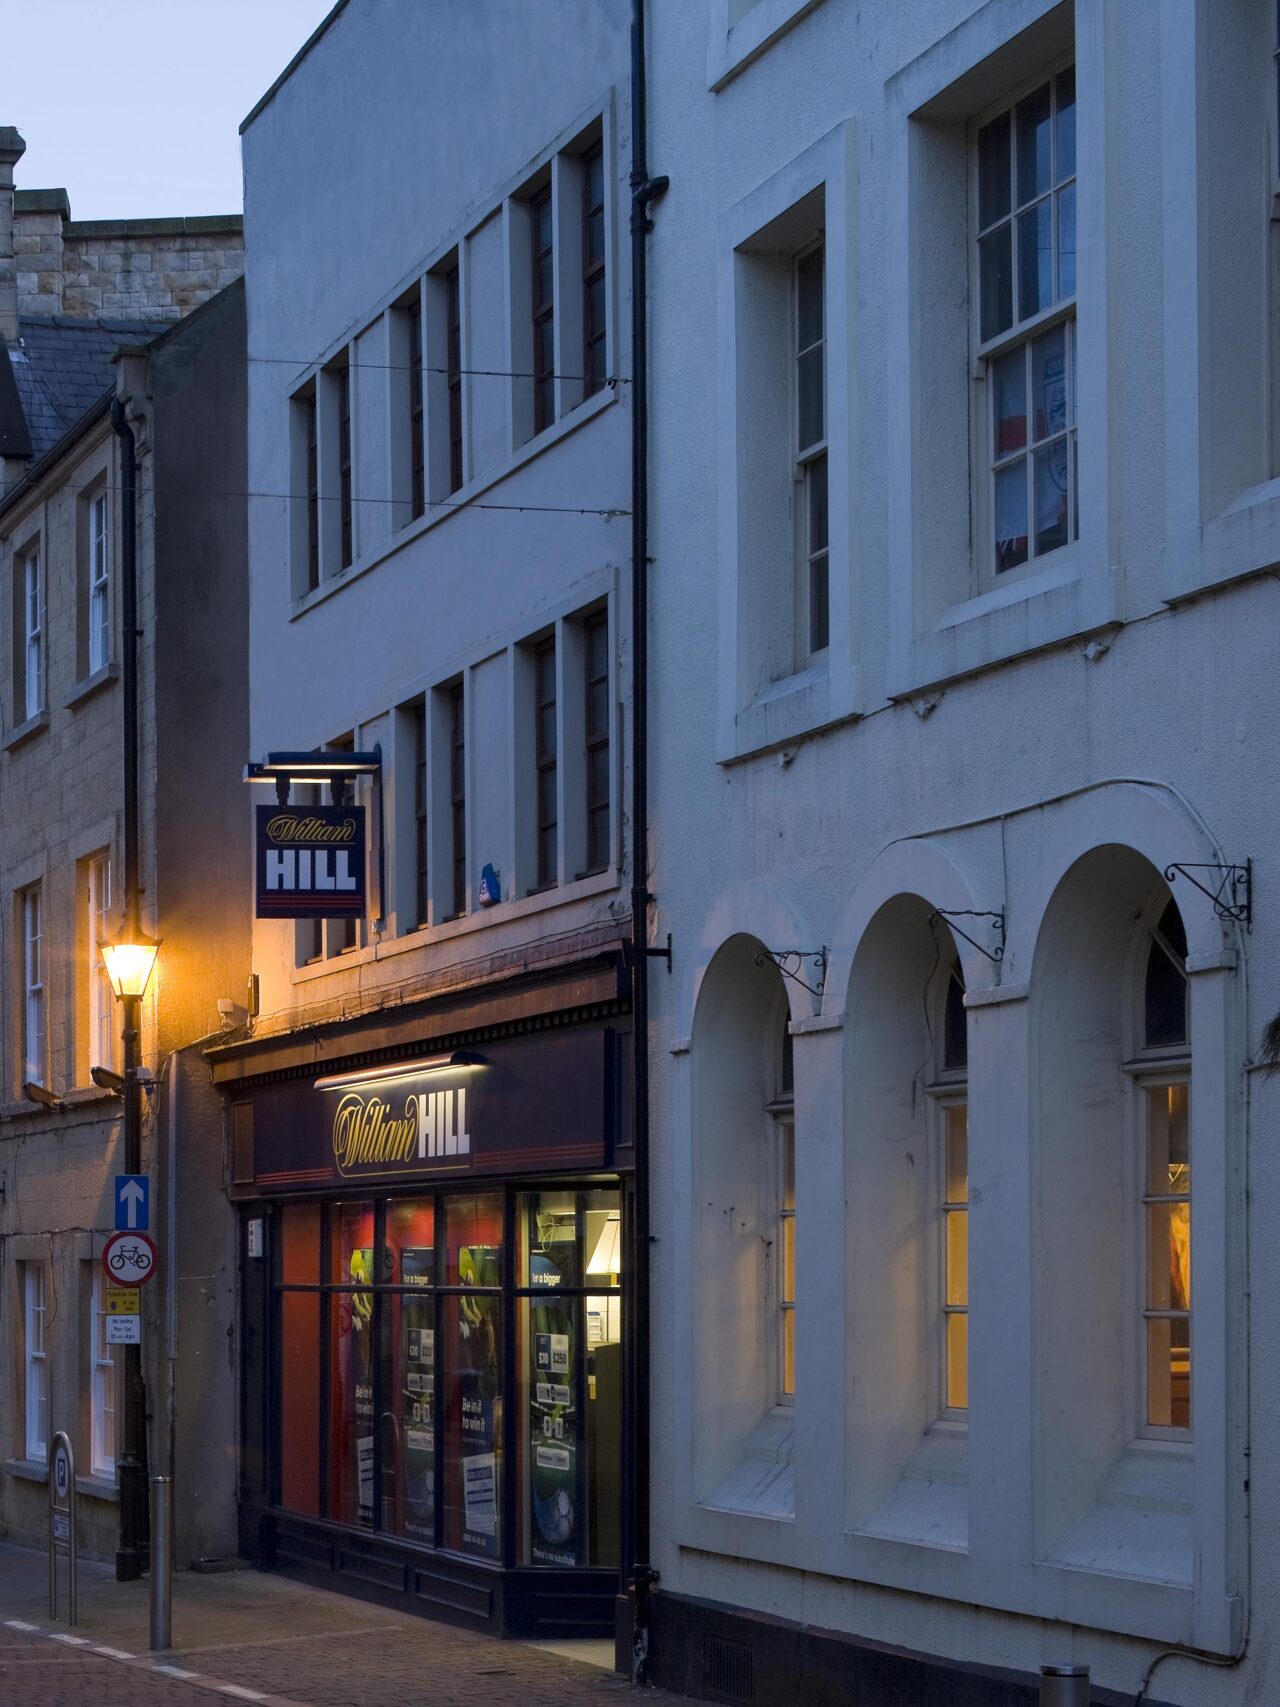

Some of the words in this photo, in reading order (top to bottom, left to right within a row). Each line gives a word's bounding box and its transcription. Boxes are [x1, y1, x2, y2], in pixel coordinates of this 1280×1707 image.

[267, 815, 356, 842] William
[266, 850, 356, 889] HILL
[333, 1093, 419, 1168] William
[418, 1088, 470, 1158] HILL
[543, 1272, 561, 1287] bigger
[462, 1396, 471, 1412] Be
[462, 1415, 469, 1430] to
[469, 1416, 481, 1431] win
